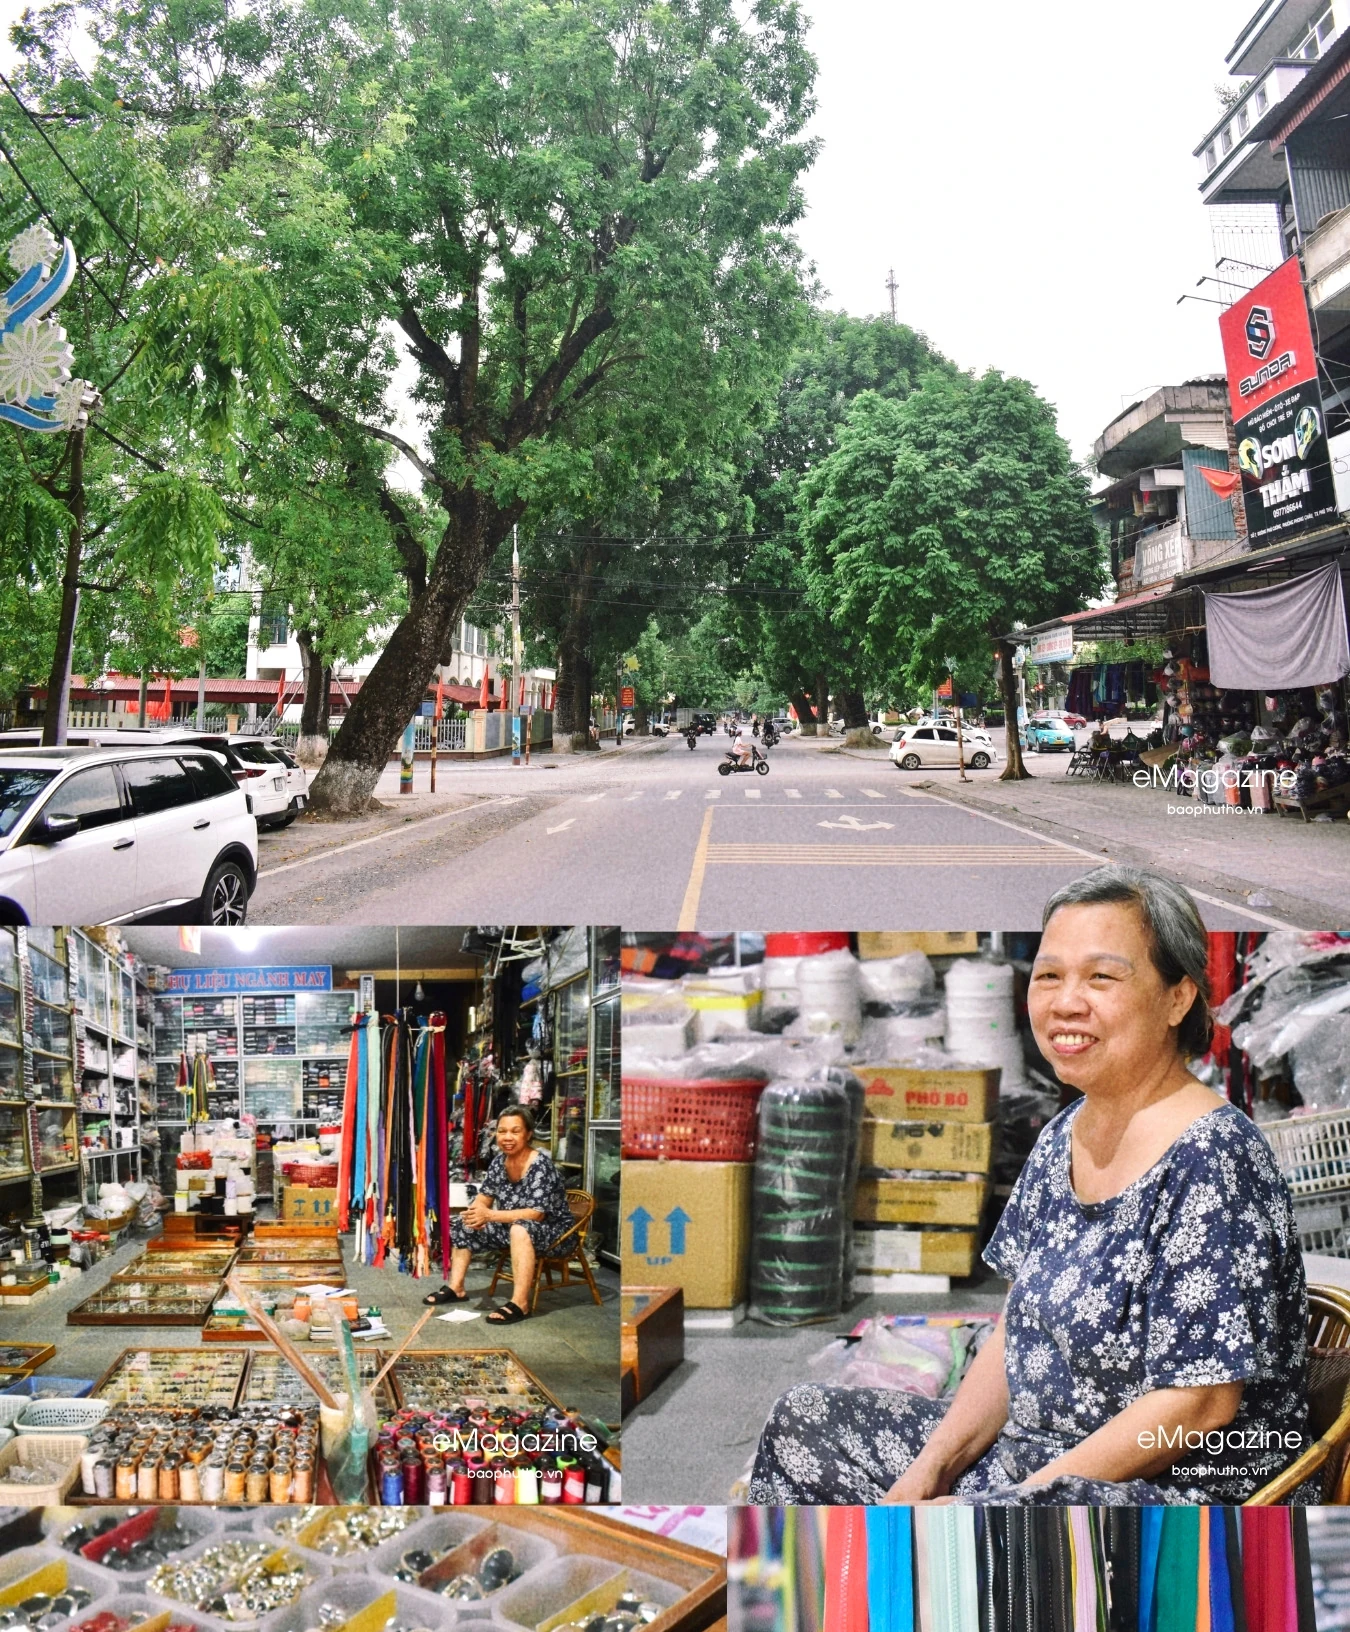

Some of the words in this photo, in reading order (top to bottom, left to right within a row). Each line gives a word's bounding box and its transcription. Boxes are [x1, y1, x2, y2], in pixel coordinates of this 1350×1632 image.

[1239, 351, 1296, 397] SUNDA
[195, 970, 232, 993] LIỆU
[235, 969, 289, 988] NGÀNH
[293, 972, 326, 987] MAY
[646, 1256, 672, 1266] UP
